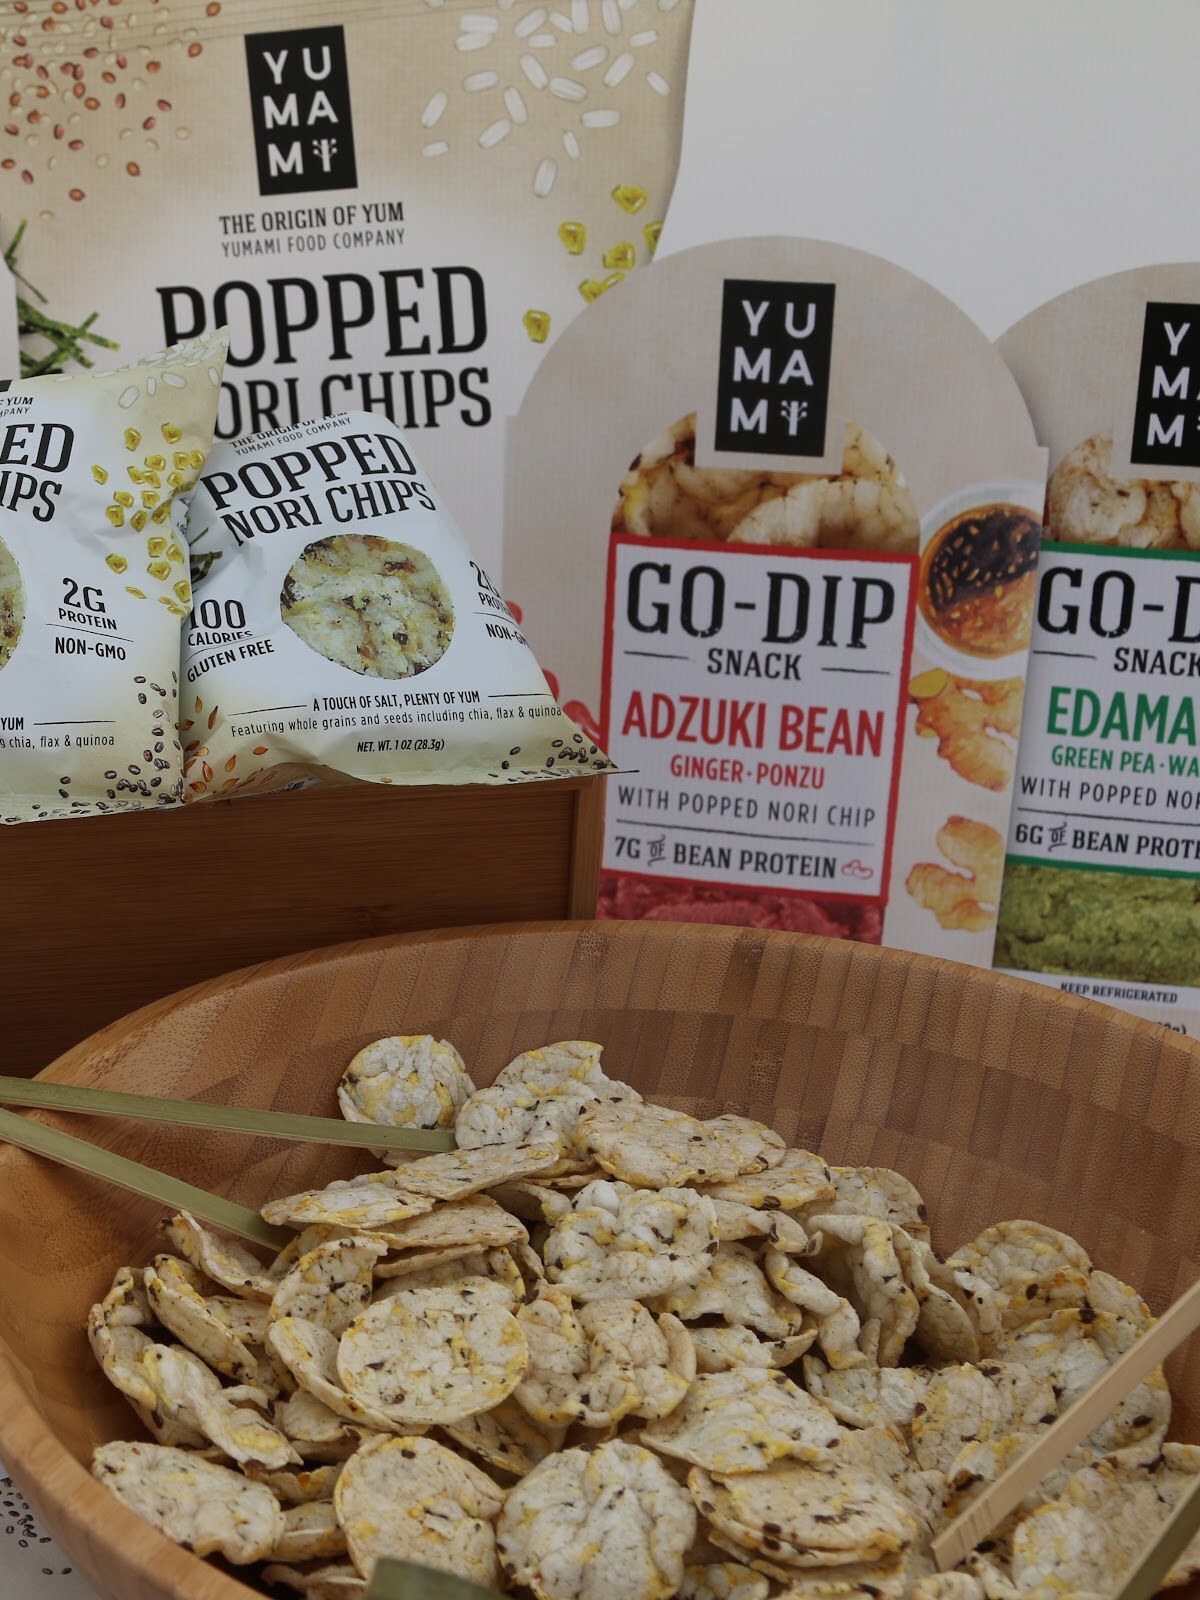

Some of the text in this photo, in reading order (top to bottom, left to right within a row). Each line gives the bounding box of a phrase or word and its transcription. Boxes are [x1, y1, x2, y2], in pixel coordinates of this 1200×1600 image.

[262, 45, 332, 85] YU
[262, 90, 339, 129] MA
[219, 201, 405, 235] THE ORIGIN OF YUM
[222, 228, 405, 257] YUMAMI FOOD COMPANY
[156, 265, 487, 368] POPPED
[742, 300, 817, 338] YU
[732, 346, 814, 386] MA
[6, 396, 34, 407] YUM
[321, 366, 491, 429] CHIPS
[235, 417, 351, 456] YUMAMI FOOD COMPANY
[200, 433, 417, 511] POPPED
[220, 479, 436, 547] NORI CHIPS
[62, 577, 106, 614] 2G
[627, 561, 896, 649] GO-DIP
[58, 607, 118, 630] PROTEIN
[189, 599, 246, 631] 100
[55, 636, 127, 661] NON-GMO
[188, 630, 253, 647] CALORIES
[187, 639, 275, 683] GLUTEN FREE
[707, 647, 802, 681] SNACK
[313, 690, 480, 712] A TOUCH OF SALT, PLENTY OF YUM
[231, 705, 562, 737] Featuring whole grains and seeds including chia, flax & quinoa
[621, 690, 885, 757] ADZUKI BEAN
[357, 741, 375, 752] NET.
[377, 740, 392, 751] WT.
[401, 739, 412, 750] OZ
[414, 738, 445, 752] (28.3g)
[1051, 744, 1113, 771] GREEN
[618, 785, 876, 828] WITH POPPED NORI CHIP
[1021, 776, 1157, 807] WITH POPPED
[1015, 824, 1043, 845] 6G
[1072, 830, 1130, 854] BEAN
[614, 836, 641, 859] 7G
[673, 843, 732, 869] BEAN
[739, 850, 836, 879] PROTEIN
[1061, 982, 1178, 1004] KEEP REFRIGERATED
